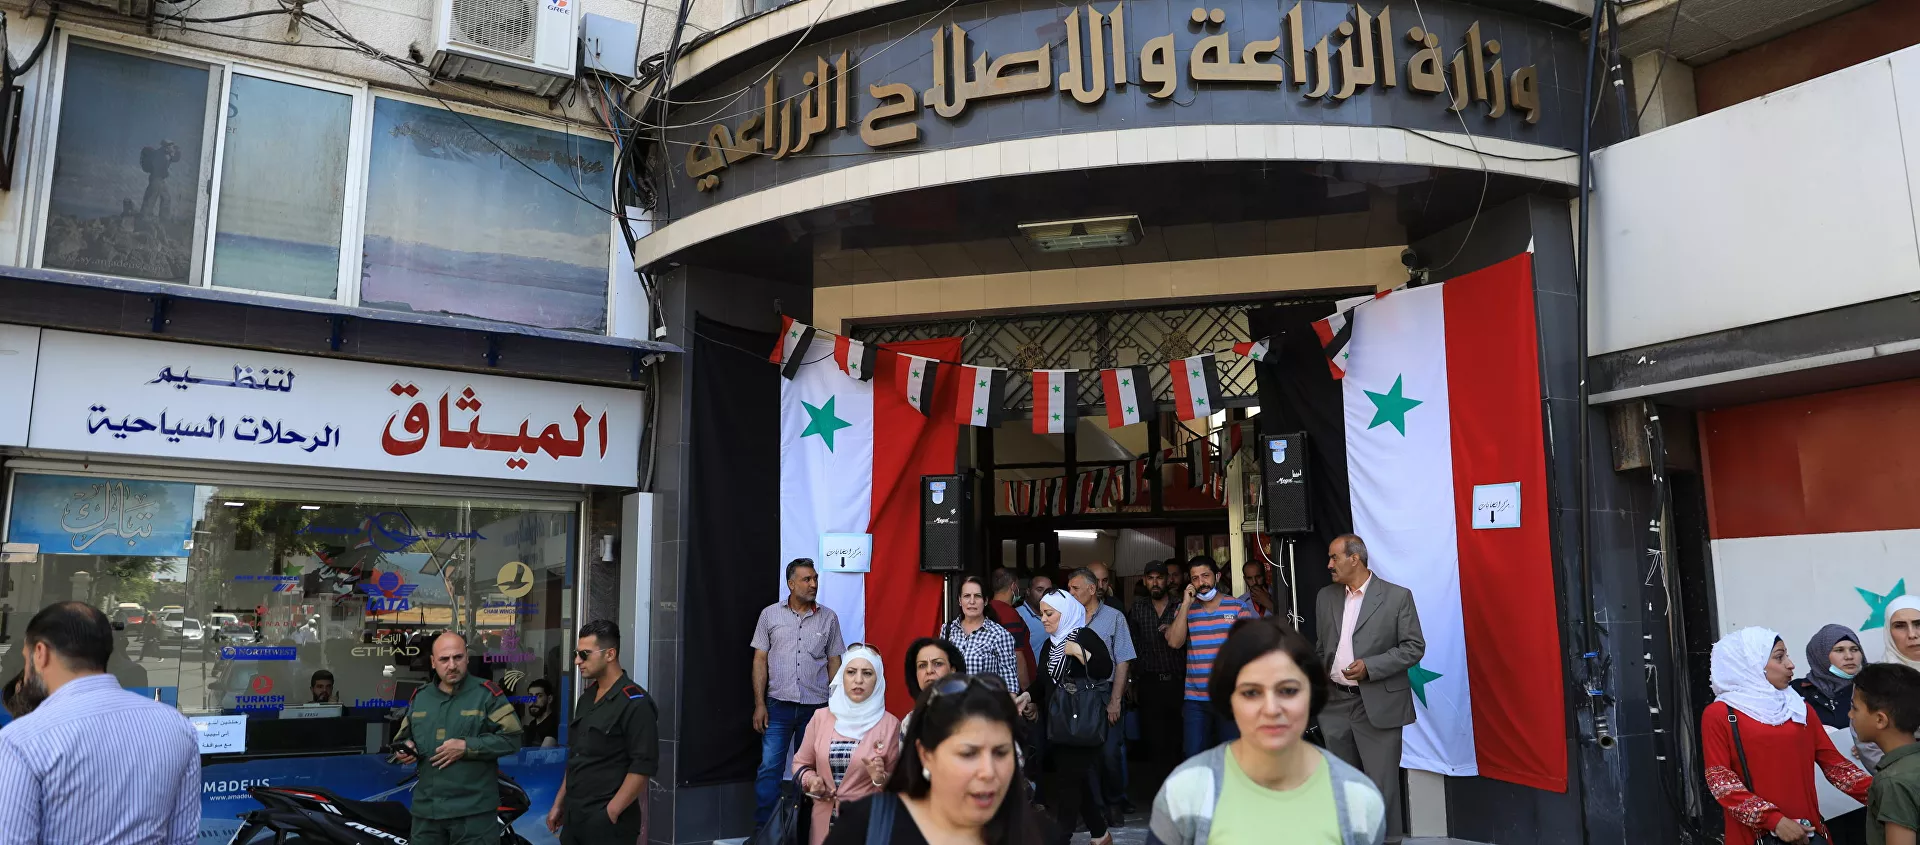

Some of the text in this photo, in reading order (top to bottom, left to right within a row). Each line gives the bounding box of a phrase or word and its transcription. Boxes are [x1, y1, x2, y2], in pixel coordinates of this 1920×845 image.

[547, 5, 570, 15] GREE
[1190, 1, 1397, 101] الزراعة
[1406, 20, 1540, 124] وزارة
[685, 49, 850, 193] الزراعي
[145, 363, 296, 393] لتنظيم
[87, 404, 341, 452] الرحلات السياحية
[381, 382, 609, 471] الميثاق
[366, 597, 409, 610] IATA
[238, 648, 296, 656] NORTHWEST
[350, 646, 421, 657] ETIHAD
[235, 695, 285, 703] TURKISH
[210, 793, 253, 801] www.amadeu
